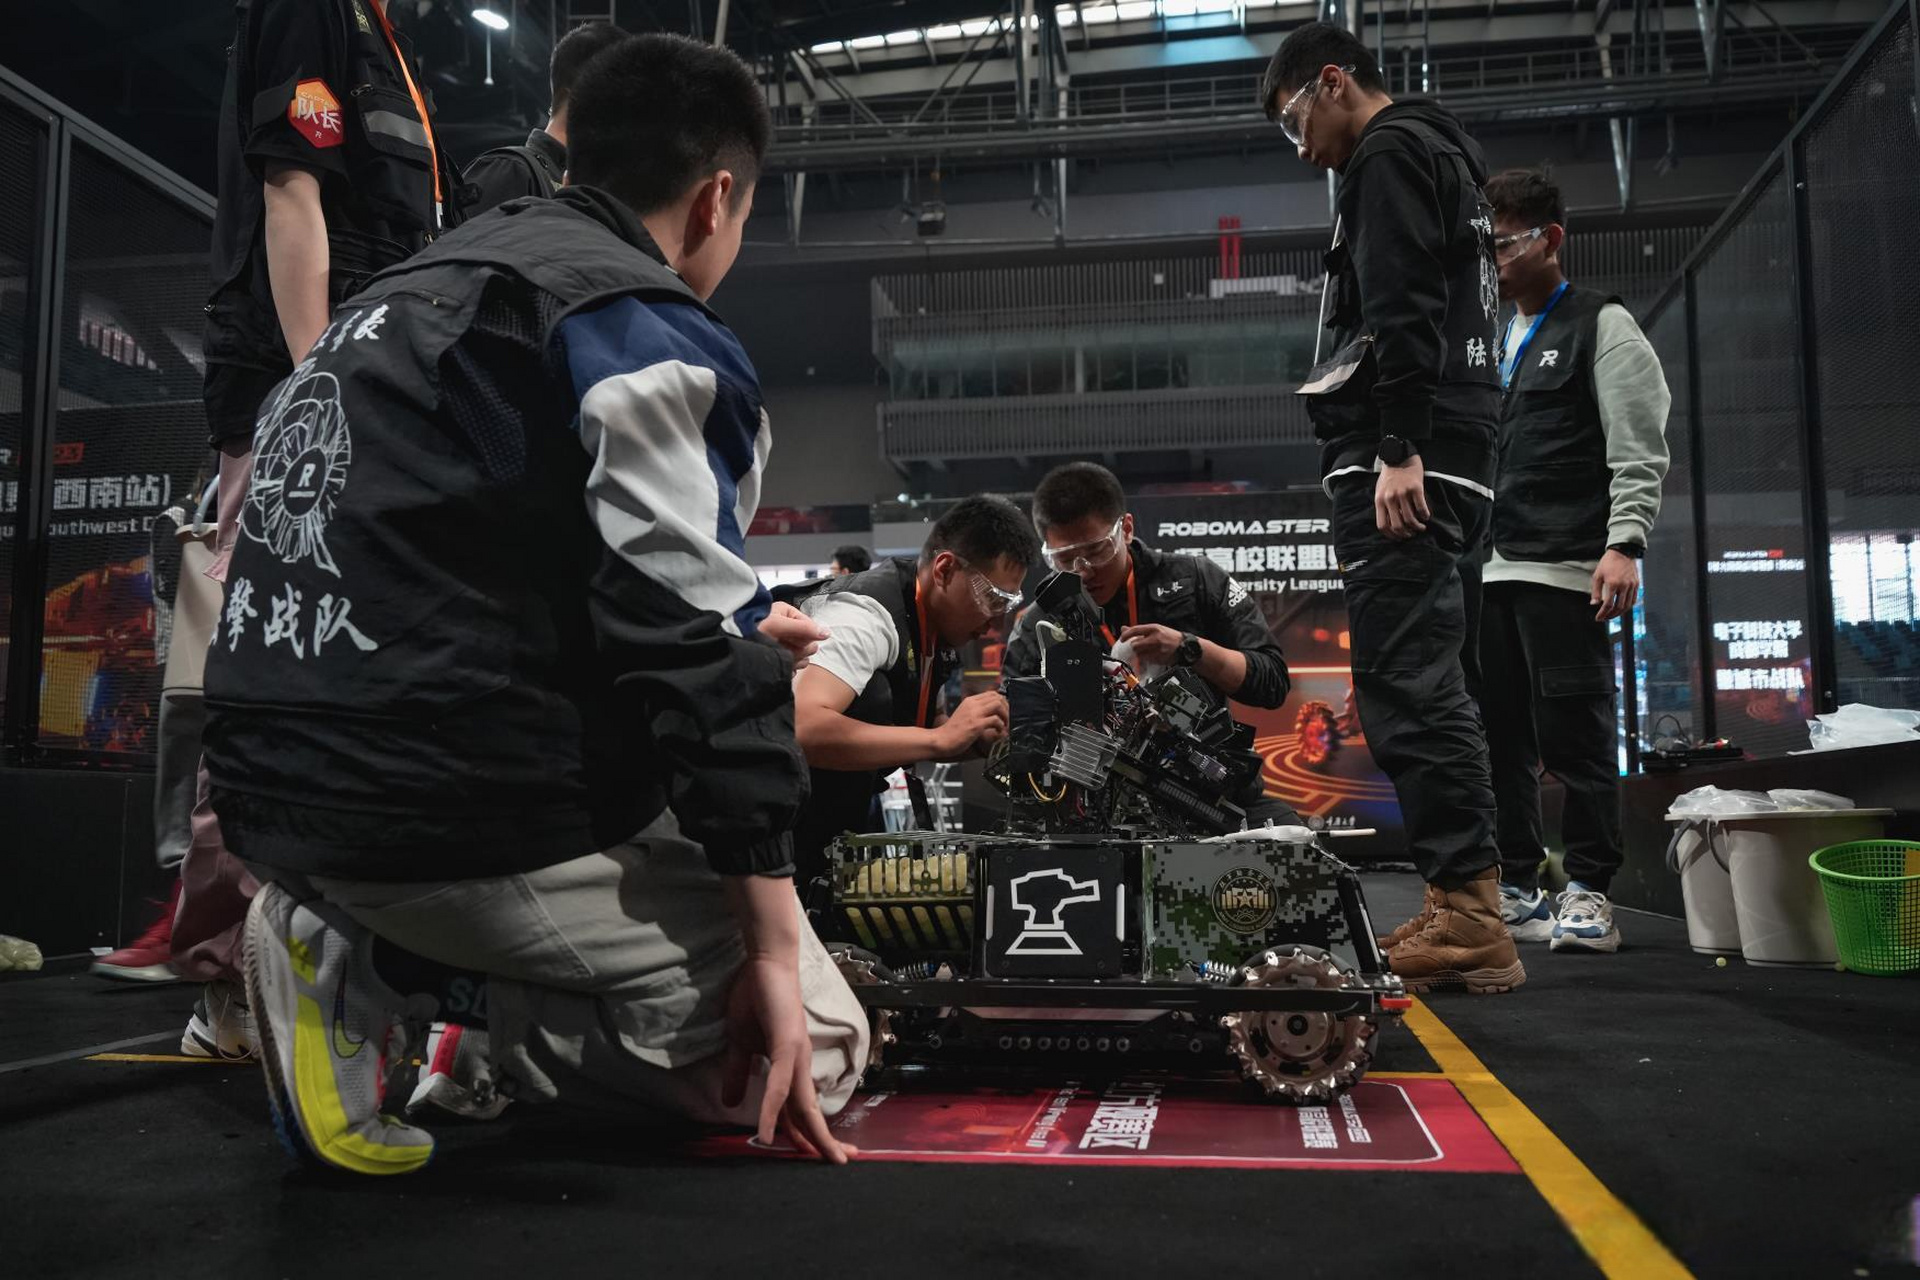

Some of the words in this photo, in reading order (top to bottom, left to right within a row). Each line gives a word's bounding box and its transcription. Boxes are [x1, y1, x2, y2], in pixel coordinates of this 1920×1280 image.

[297, 96, 341, 134] 队长
[49, 518, 139, 535] outhwest
[1157, 518, 1331, 537] ROBOMASTER
[1238, 578, 1287, 594] ersity
